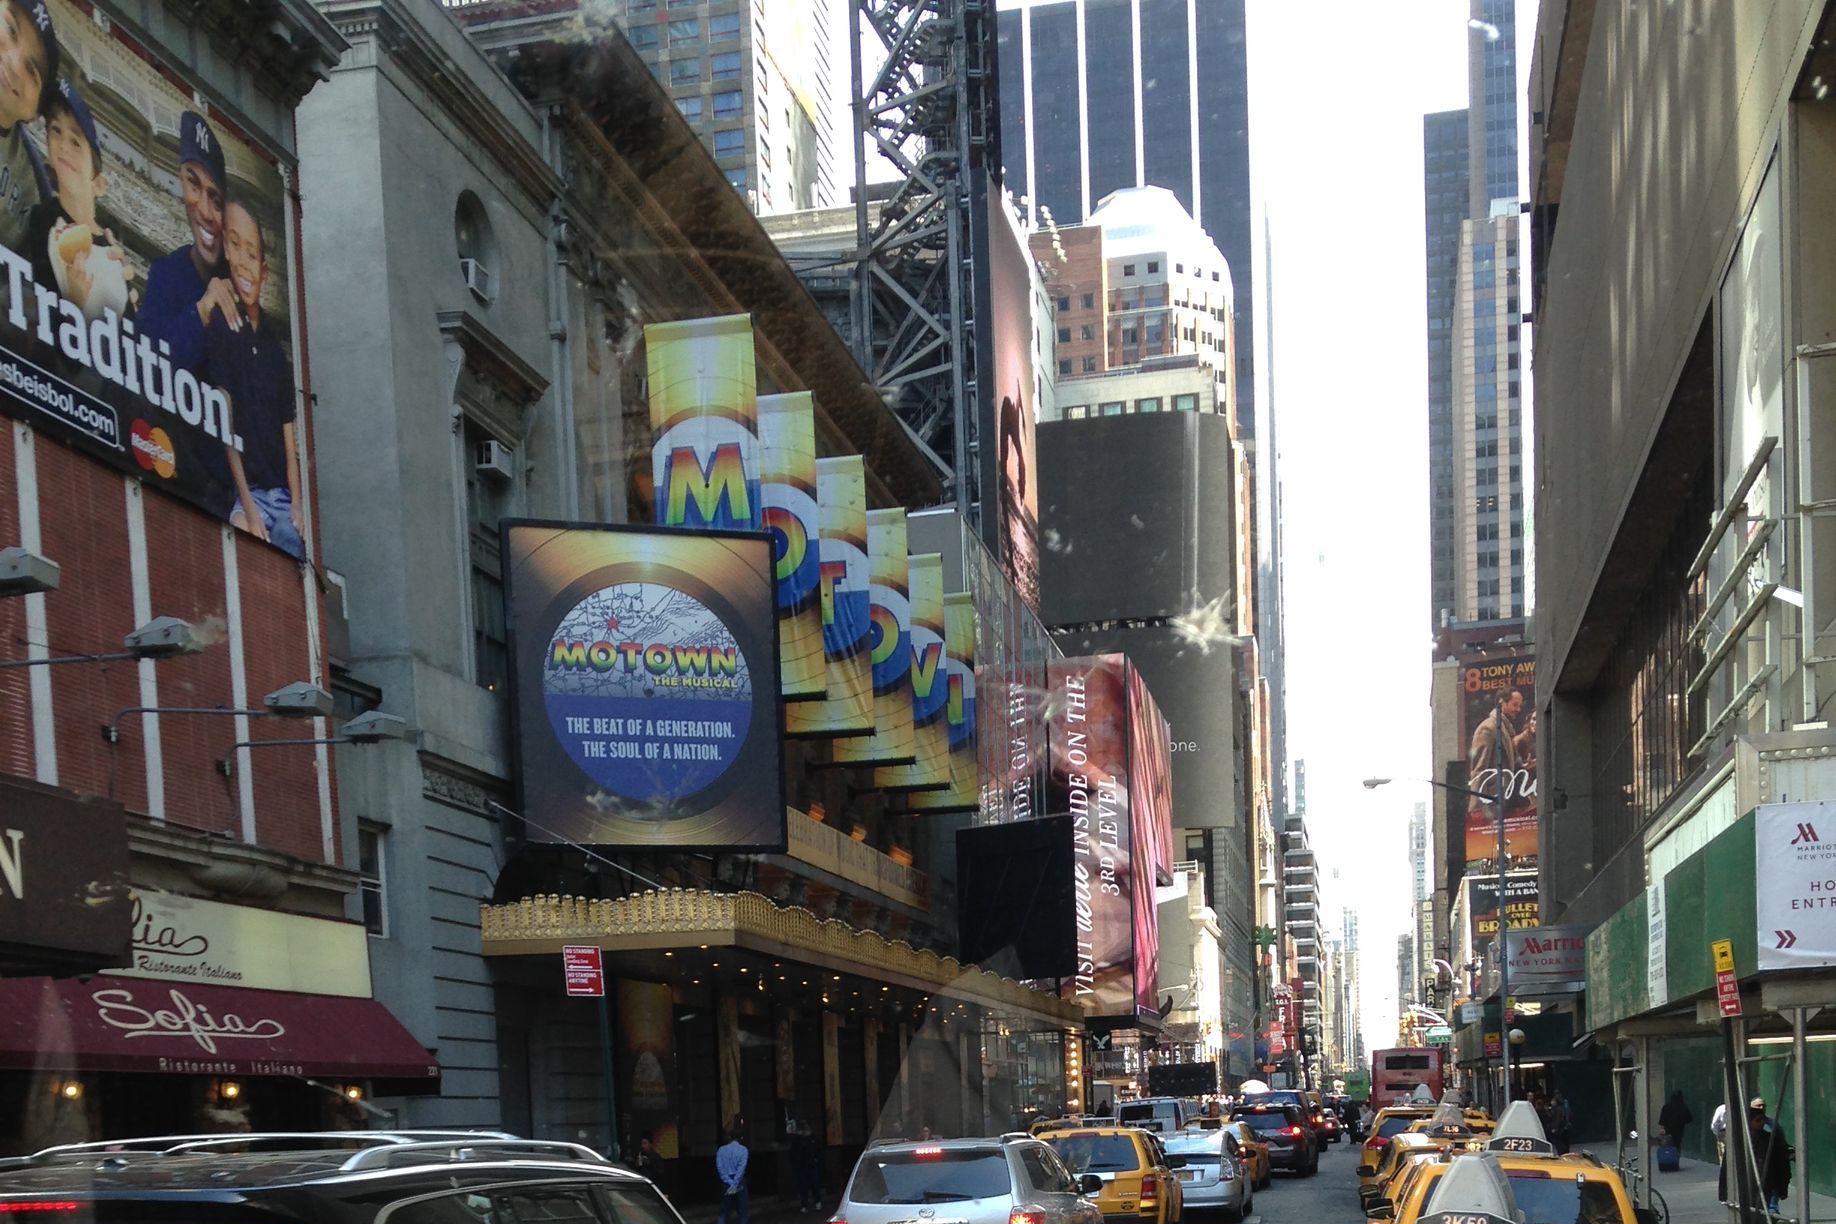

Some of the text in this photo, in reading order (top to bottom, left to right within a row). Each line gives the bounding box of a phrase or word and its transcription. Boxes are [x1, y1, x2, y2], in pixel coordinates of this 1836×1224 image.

[0, 245, 244, 452] Tradition.
[549, 638, 738, 675] MOTOWN
[654, 676, 738, 688] THE MUSICAL
[1465, 668, 1481, 692] 8
[1481, 664, 1514, 677] TONY
[1482, 677, 1512, 691] BEST
[1066, 675, 1085, 723] THE
[566, 716, 736, 738] THE BEAT OF A GENERATION.
[582, 741, 723, 760] THE SOUL OF A NATION.
[1068, 731, 1087, 766] ON
[1069, 773, 1091, 856] INSIDE
[1098, 775, 1120, 896] 3RD LEVEL
[1507, 880, 1536, 889] Comedy
[1511, 911, 1531, 919] OVER
[1076, 939, 1095, 996] VISIT
[91, 989, 285, 1054] Sofia
[159, 1057, 303, 1075] Ristorante Italiano
[1504, 1139, 1533, 1151] 2F23
